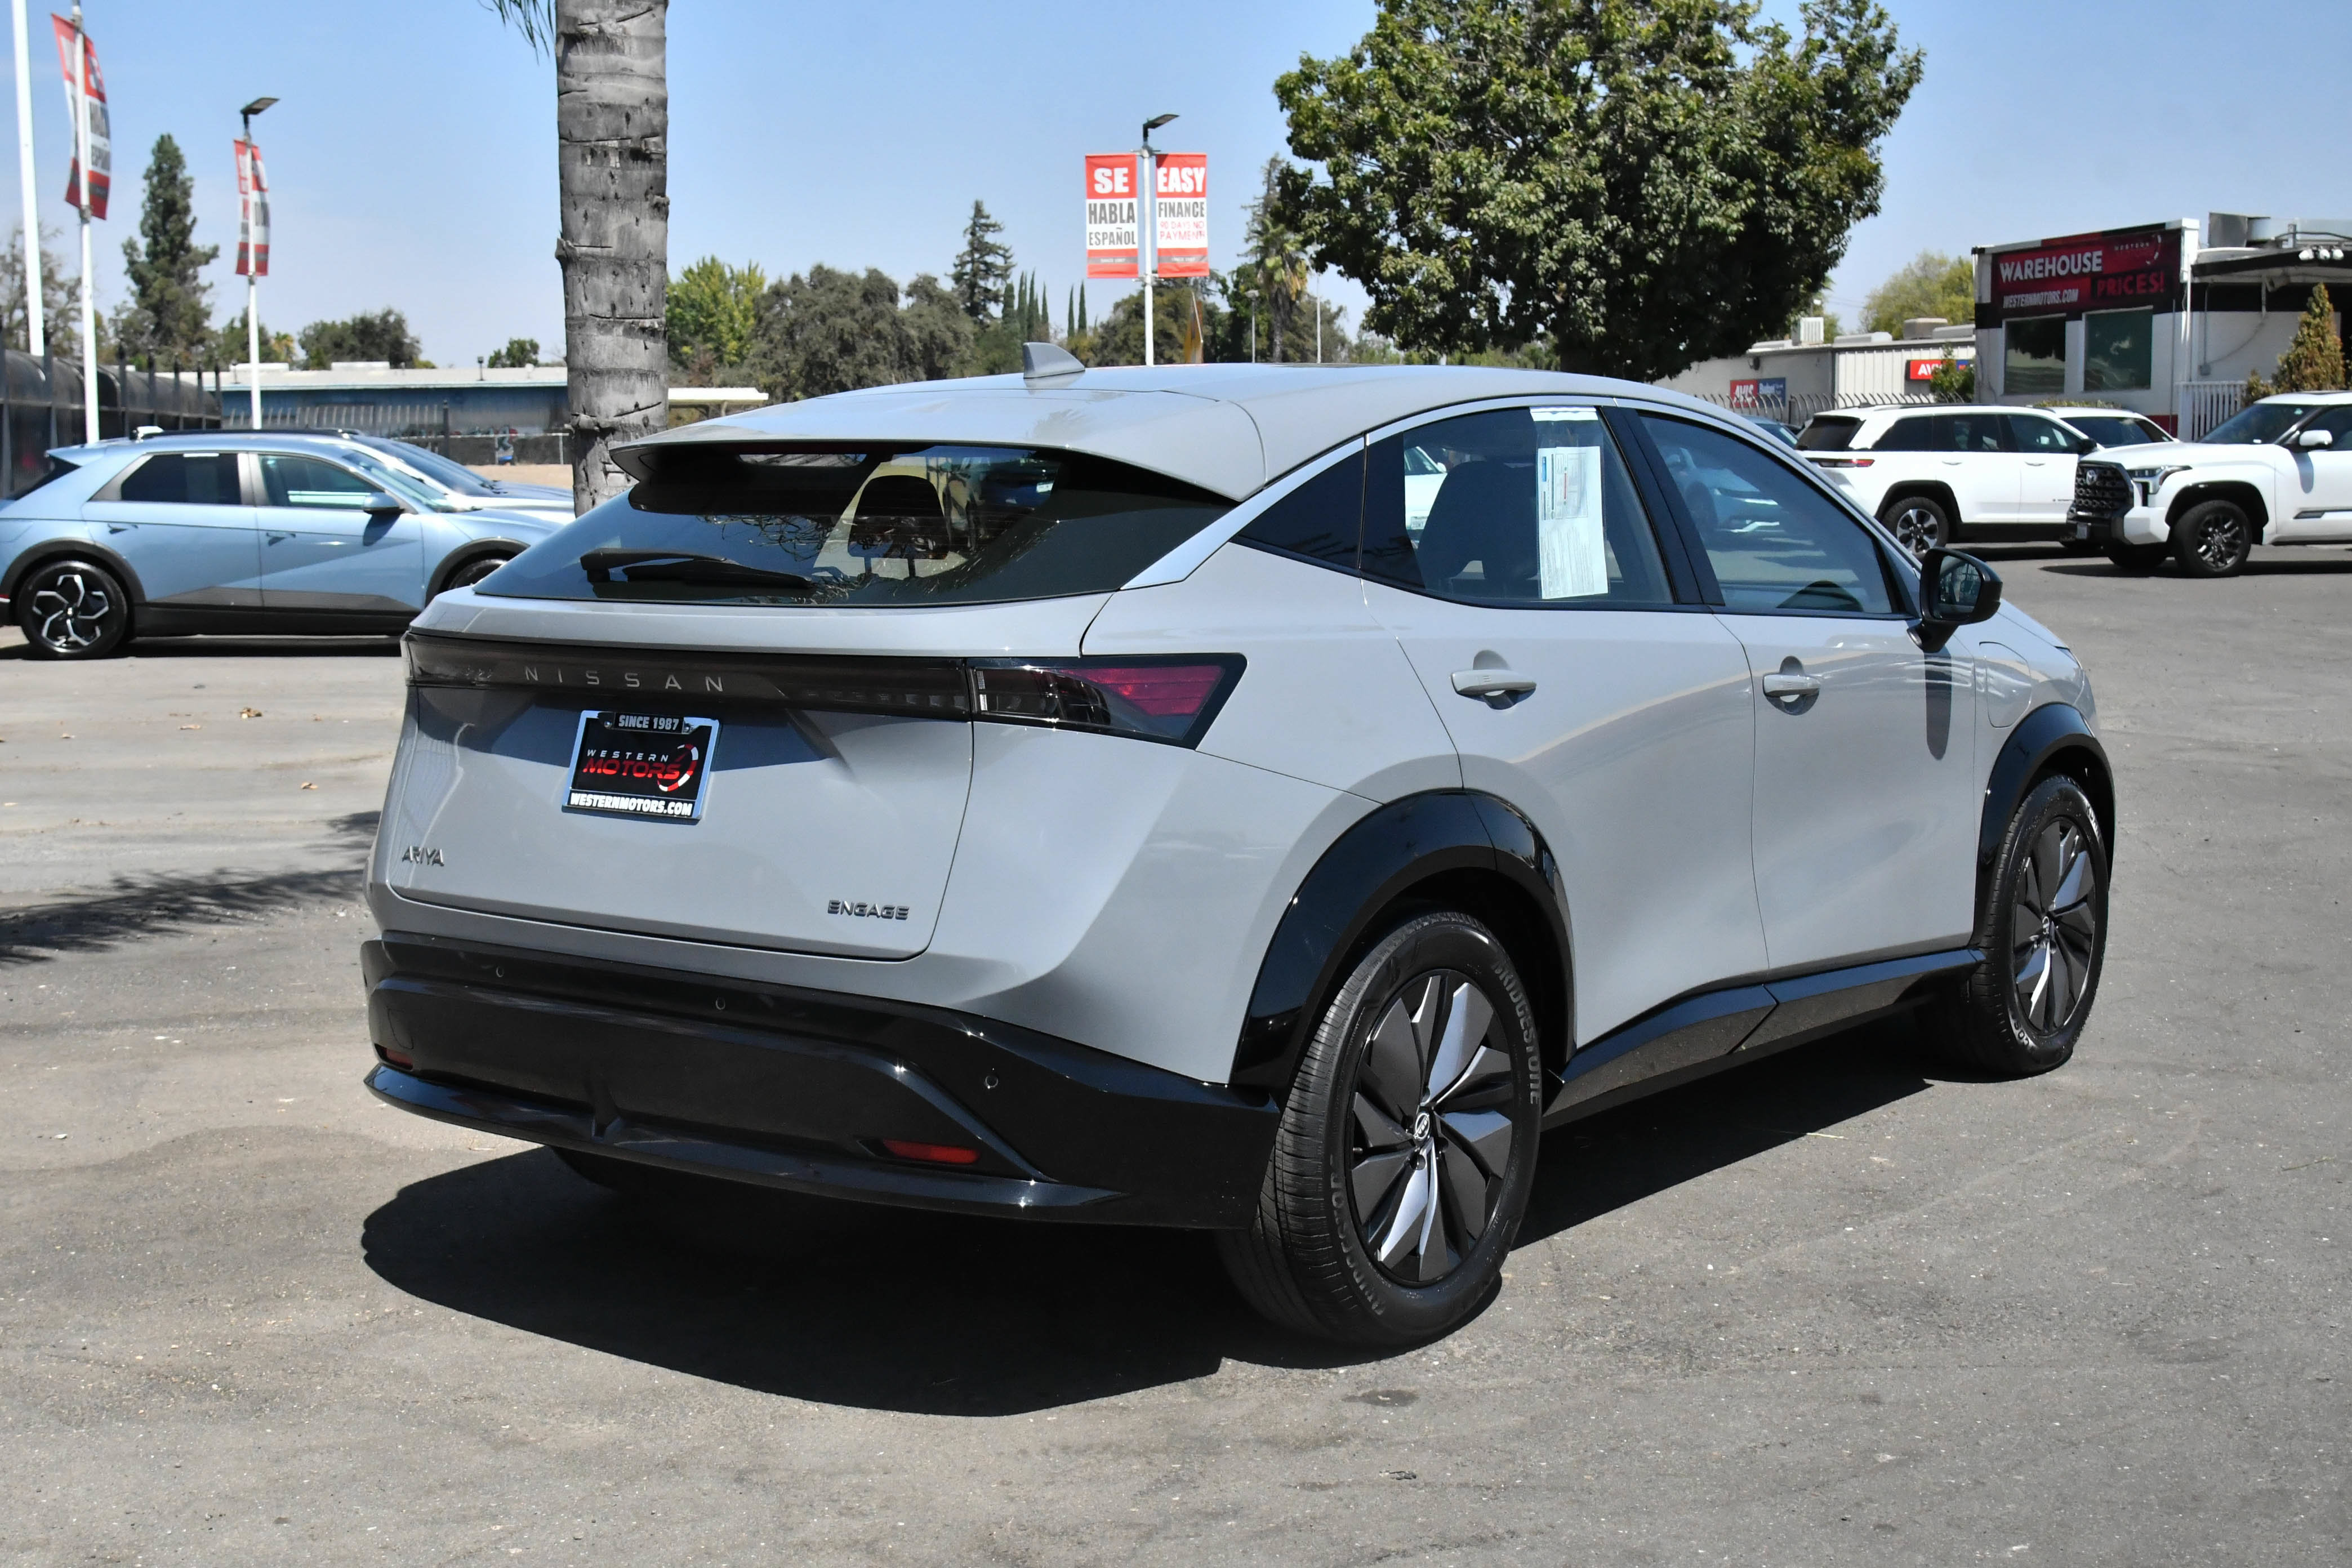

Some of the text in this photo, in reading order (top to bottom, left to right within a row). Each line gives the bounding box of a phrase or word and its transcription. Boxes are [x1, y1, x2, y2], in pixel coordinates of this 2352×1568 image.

[1094, 167, 1129, 194] SE
[1157, 167, 1206, 193] EASY
[1088, 202, 1136, 225] HABLA
[1158, 201, 1205, 218] FINANCE
[1088, 227, 1136, 246] ESPAÑOL
[1999, 250, 2103, 283] WAREHOUSE
[2097, 271, 2165, 297] PRICES!
[2003, 288, 2079, 309] WESTERNMOTORS.COM
[525, 665, 723, 692] NISSAN
[618, 714, 680, 730] SINCE 1987
[586, 749, 669, 762] WESTERN
[582, 758, 681, 779] MOTORS
[570, 792, 693, 816] WESTERNMOTORS.COM
[402, 845, 444, 867] ARIYA
[827, 899, 910, 921] ENGAGE
